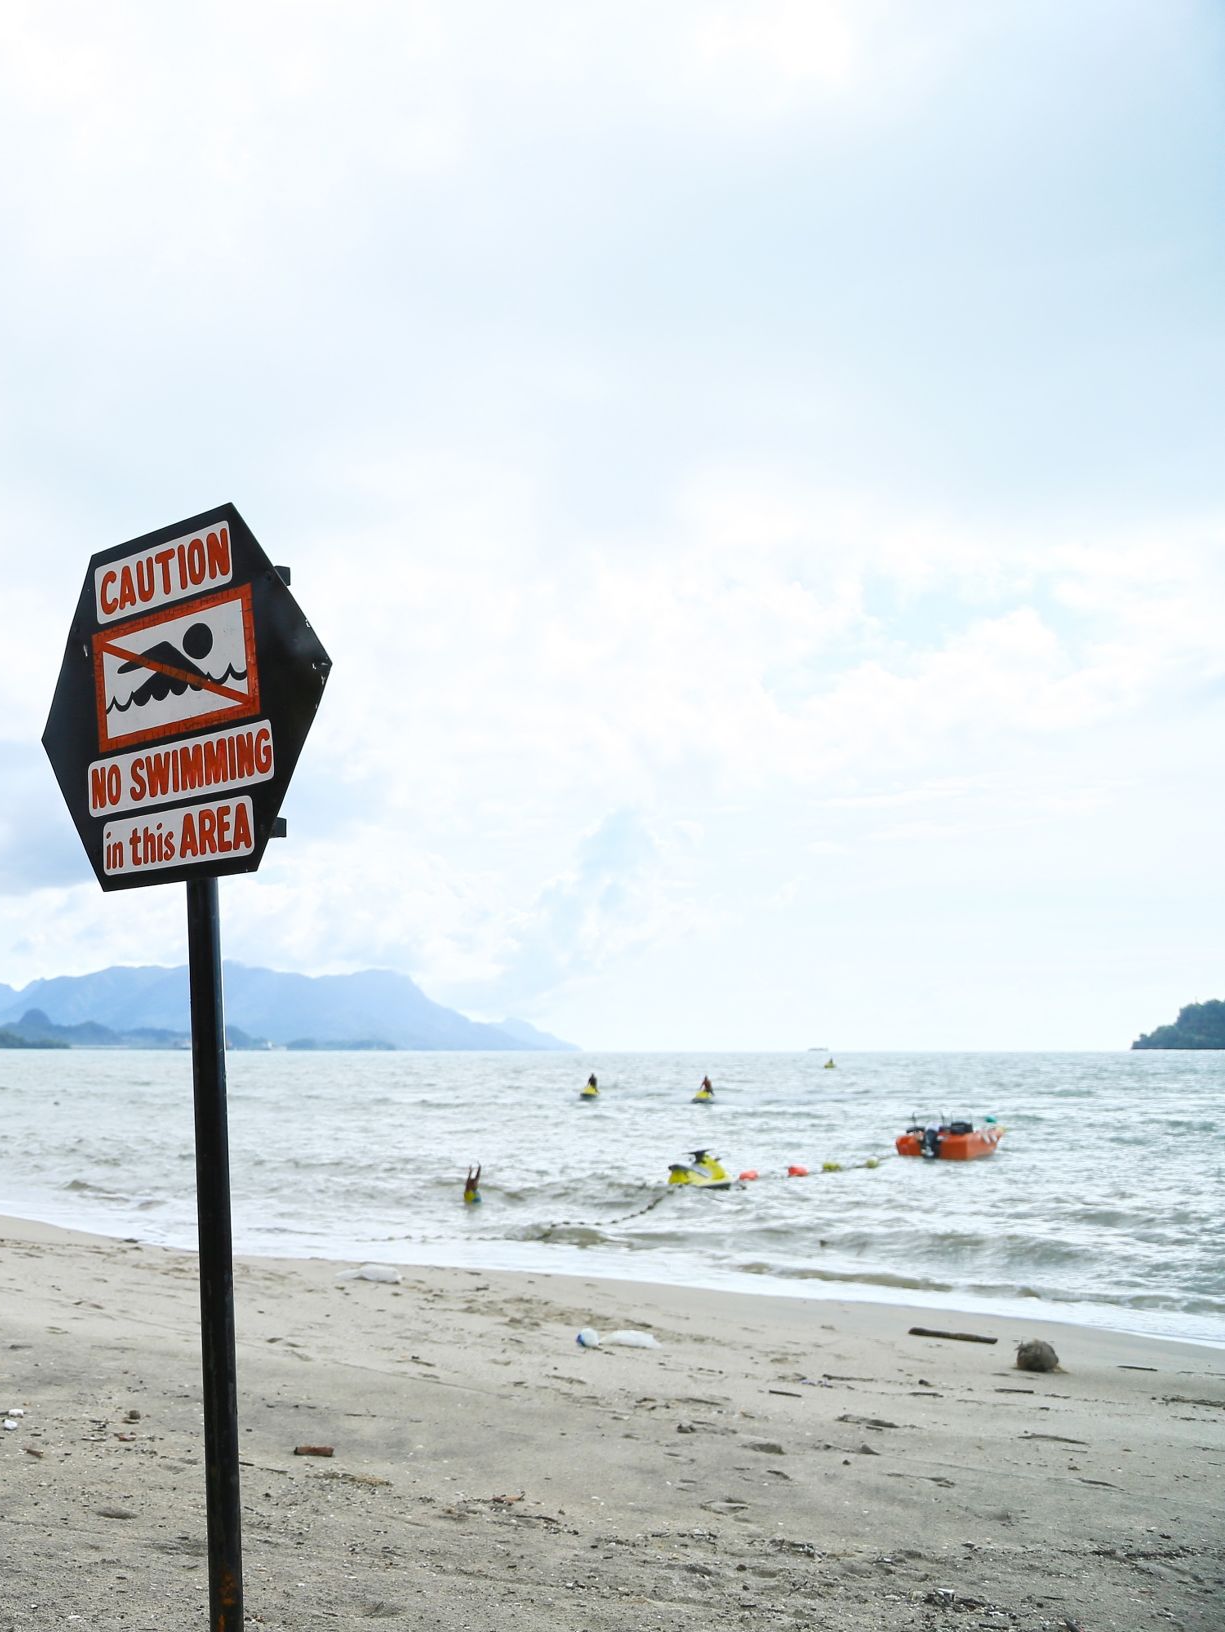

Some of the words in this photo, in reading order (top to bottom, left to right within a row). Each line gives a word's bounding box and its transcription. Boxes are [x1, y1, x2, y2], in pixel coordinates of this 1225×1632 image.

[99, 527, 231, 616] CAUTION
[91, 764, 122, 810] NO
[129, 727, 273, 798] SWIMMING
[105, 831, 124, 870] in
[130, 822, 176, 866] this
[179, 802, 252, 859] AREA
